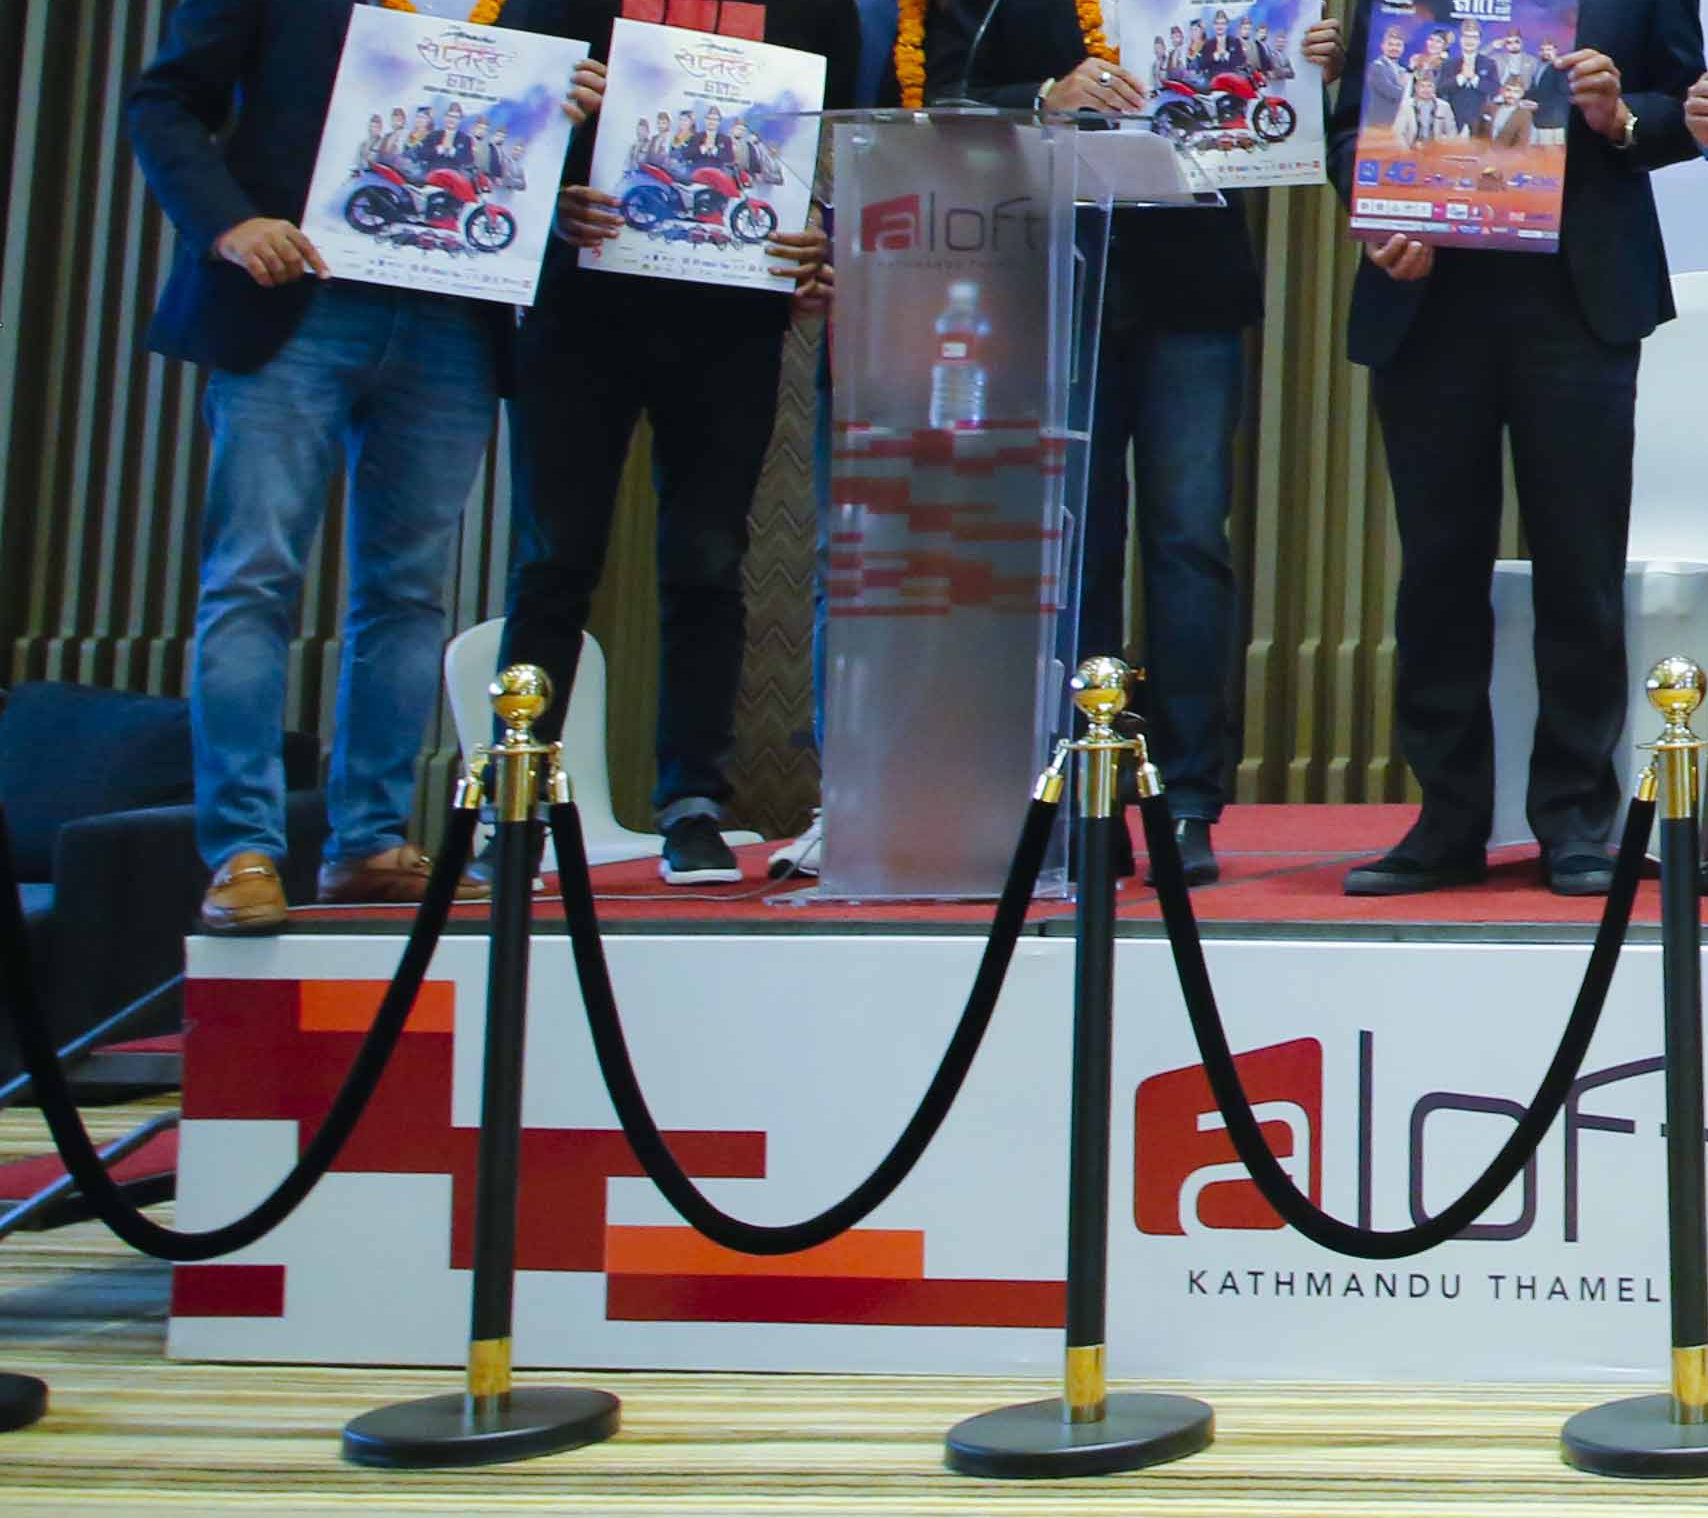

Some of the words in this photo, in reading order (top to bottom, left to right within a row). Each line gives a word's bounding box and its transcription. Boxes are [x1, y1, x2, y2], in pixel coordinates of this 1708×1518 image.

[860, 191, 1047, 252] aloft
[1188, 1269, 1462, 1300] KATHMANDU
[1488, 1274, 1662, 1303] THAMEL
